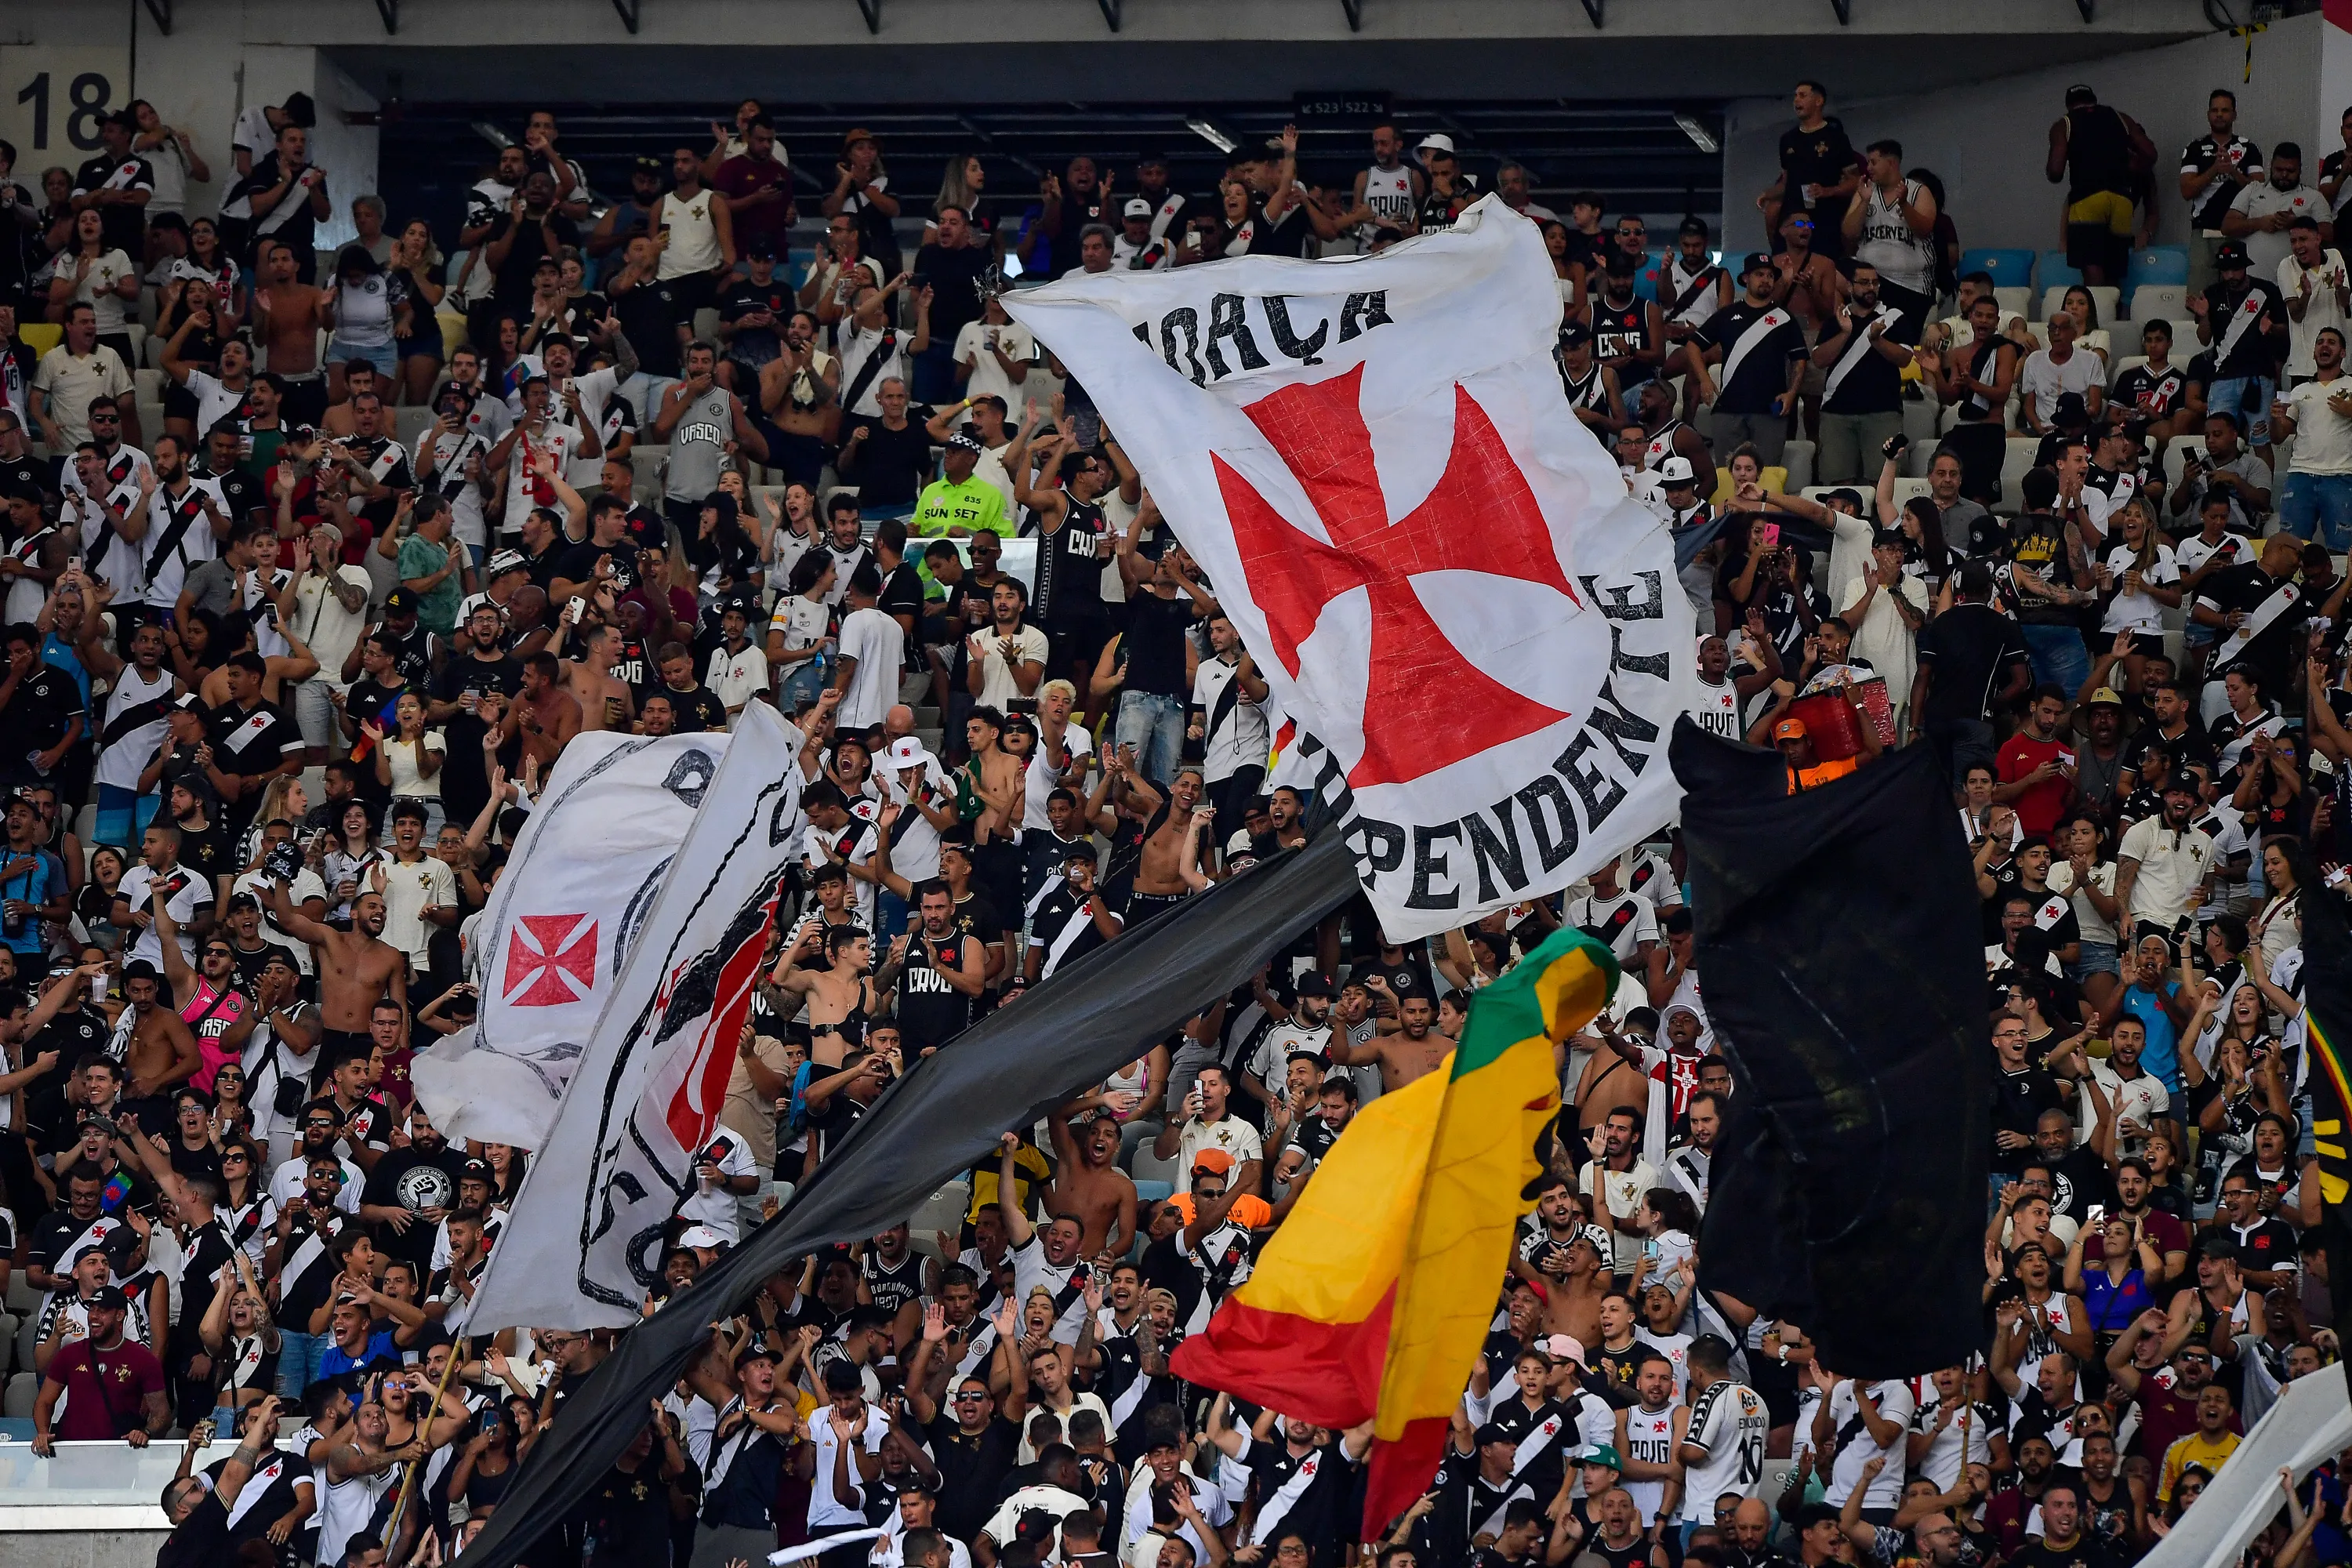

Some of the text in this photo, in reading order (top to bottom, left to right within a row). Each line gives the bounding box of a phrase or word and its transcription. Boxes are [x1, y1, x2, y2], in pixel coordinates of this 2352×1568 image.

[18, 71, 111, 151] 18
[1316, 103, 1370, 114] 523 522
[1597, 332, 1642, 358] CRG
[680, 423, 722, 448] VASCO
[964, 495, 981, 504] 835
[924, 509, 979, 521] SUN SET
[1068, 529, 1098, 558] CRV
[608, 661, 643, 684] RVG
[1699, 711, 1735, 737] RVG
[1302, 569, 1670, 910] PENDENTE
[1283, 1042, 1300, 1052] Ace
[405, 1170, 423, 1181] VASCO
[430, 1170, 445, 1181] GAMA
[400, 1189, 418, 1209] RESPEITO
[1741, 1392, 1758, 1409] Ace
[1738, 1417, 1766, 1429] EMUNDO
[1737, 1435, 1763, 1485] 10
